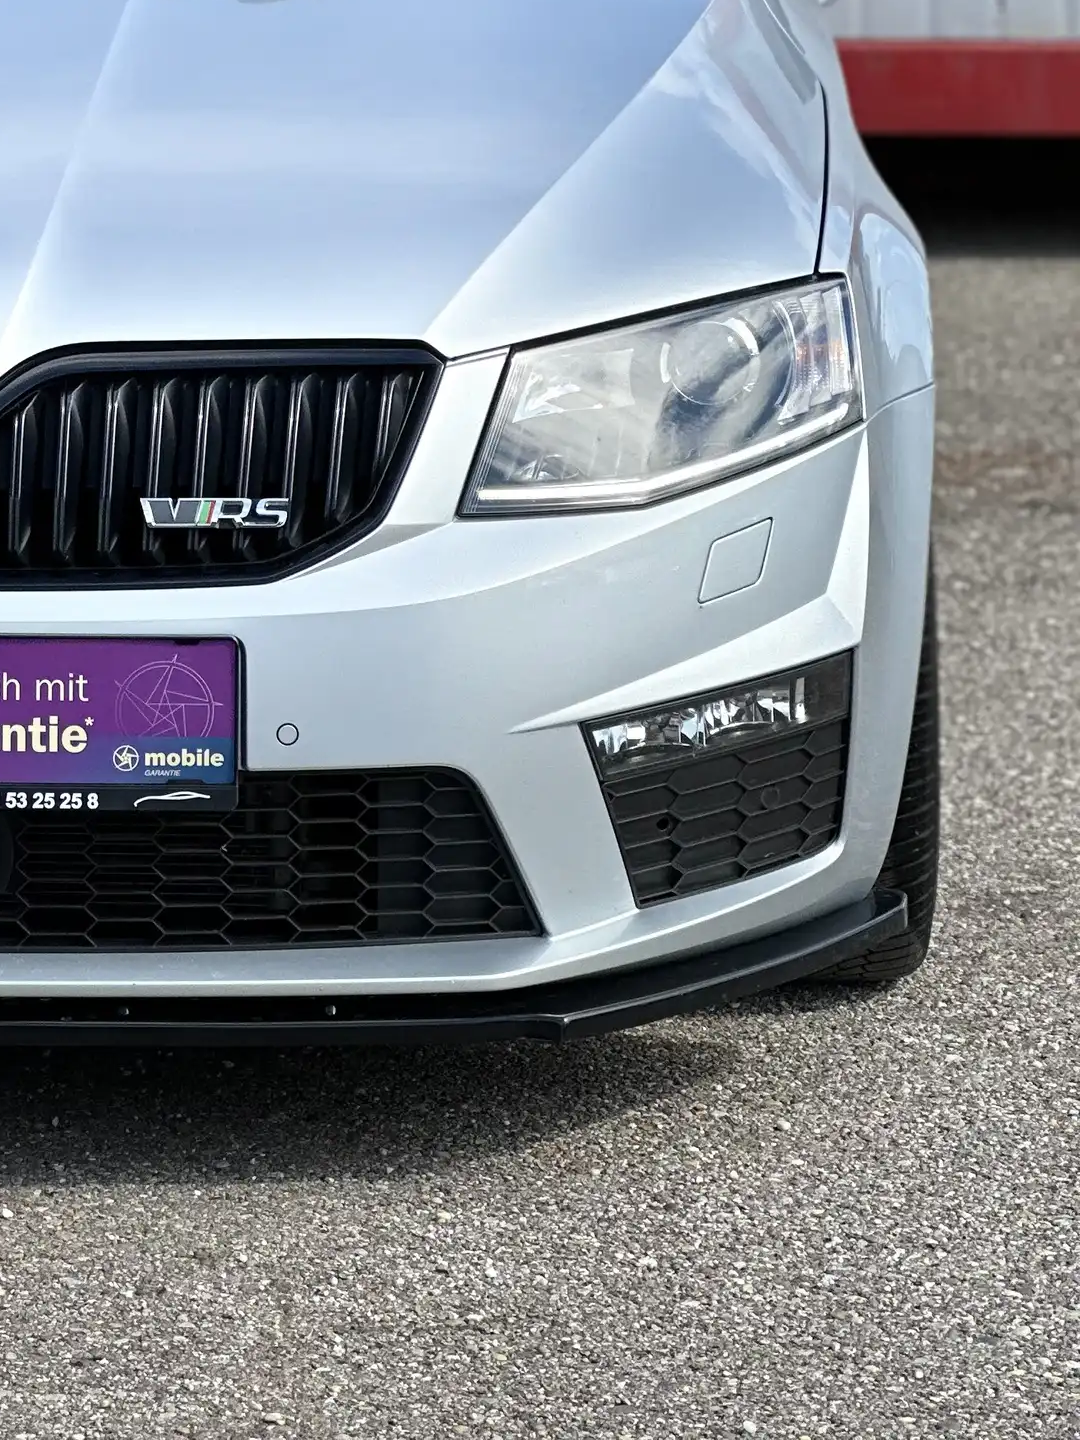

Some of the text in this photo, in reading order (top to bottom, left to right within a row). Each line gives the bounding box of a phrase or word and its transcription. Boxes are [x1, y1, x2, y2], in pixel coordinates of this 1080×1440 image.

[35, 672, 89, 702] mit
[144, 748, 225, 768] mobile
[144, 769, 182, 777] GARANTIE
[5, 791, 27, 809] 53
[32, 792, 55, 809] 25
[59, 792, 82, 810] 25
[87, 793, 99, 810] 8
